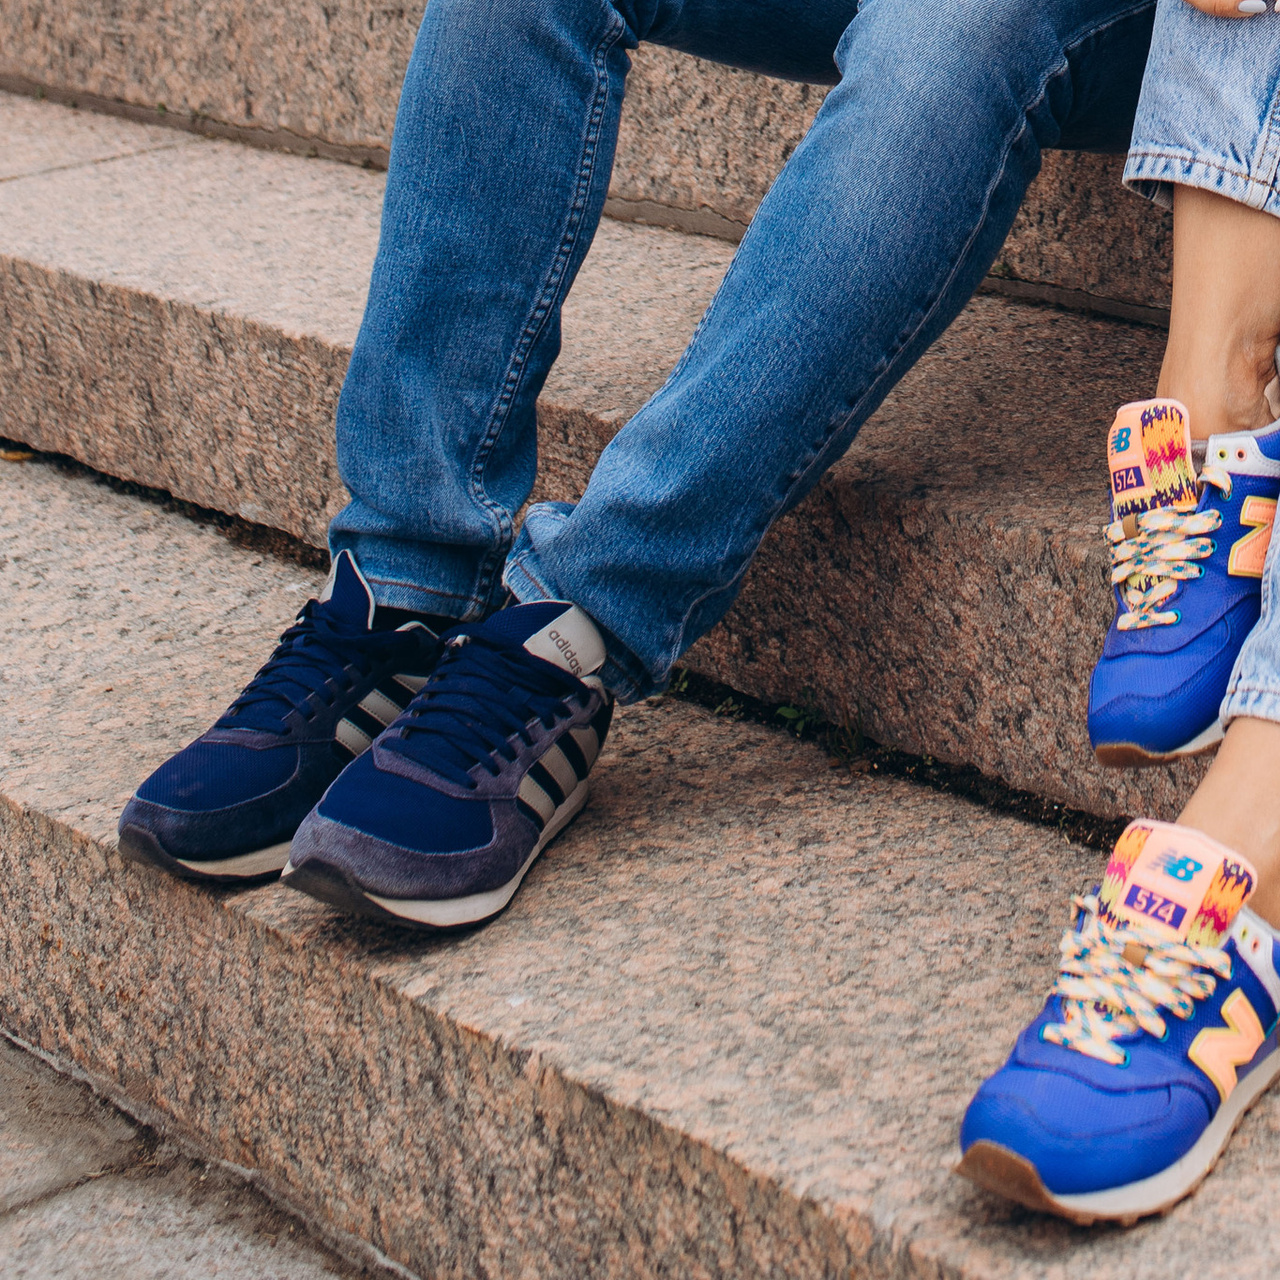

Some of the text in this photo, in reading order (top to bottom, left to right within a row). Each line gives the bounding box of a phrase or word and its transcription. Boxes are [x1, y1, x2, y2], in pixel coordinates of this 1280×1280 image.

[1115, 468, 1137, 492] 574
[548, 630, 582, 677] adidas
[1133, 887, 1176, 925] 574
